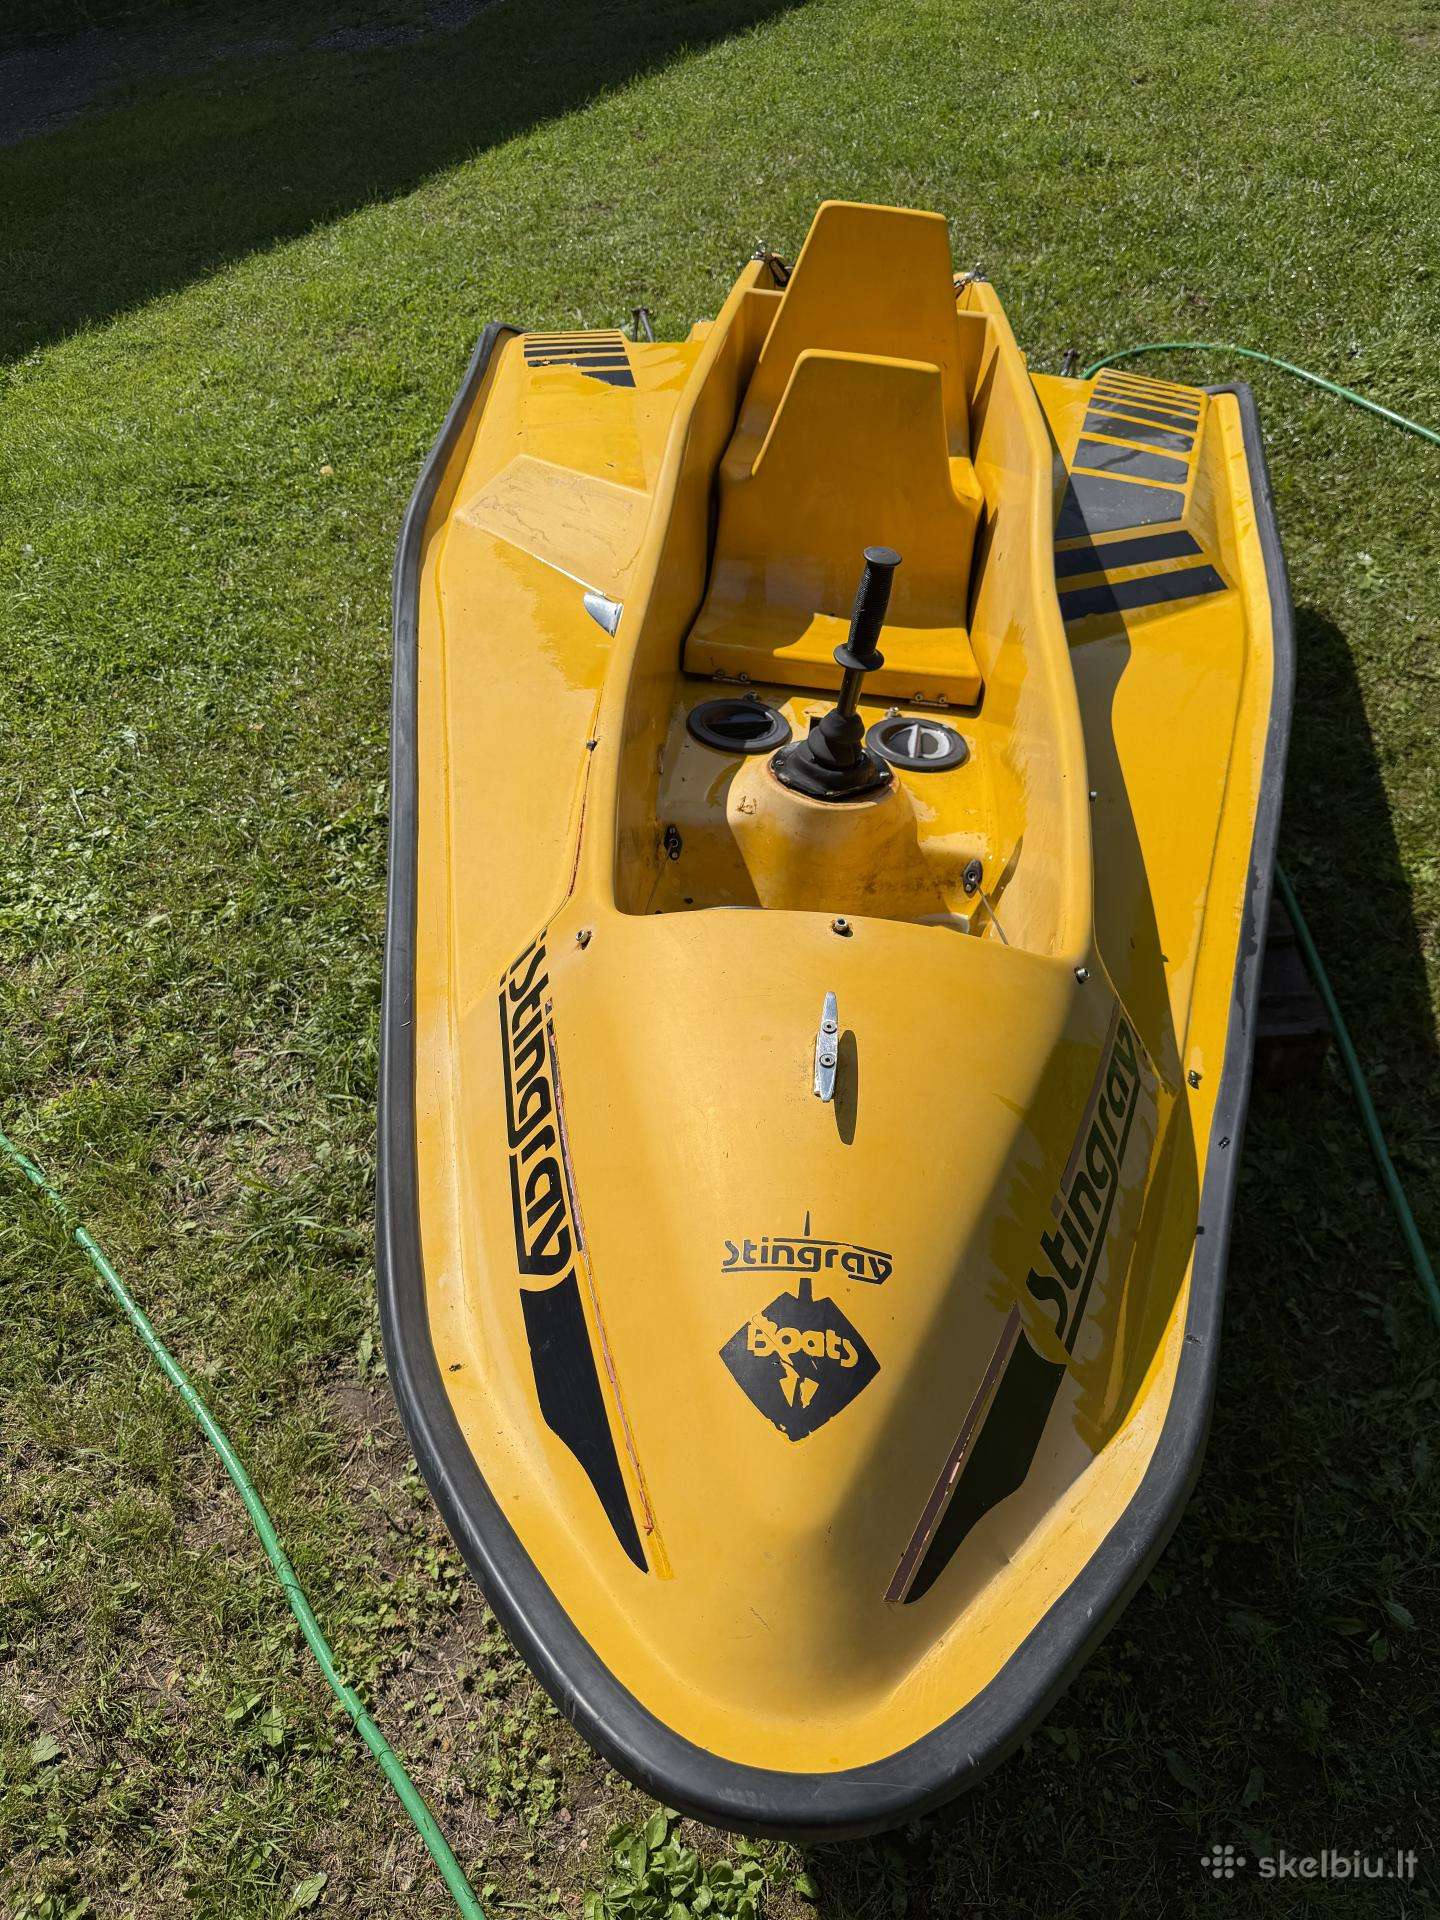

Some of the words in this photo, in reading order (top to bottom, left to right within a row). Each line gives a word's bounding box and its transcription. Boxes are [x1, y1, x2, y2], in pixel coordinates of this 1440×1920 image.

[499, 943, 573, 1276] Stingray
[1026, 1016, 1141, 1356] Stingray
[721, 1236, 893, 1285] Stingray
[747, 1315, 859, 1368] Boats
